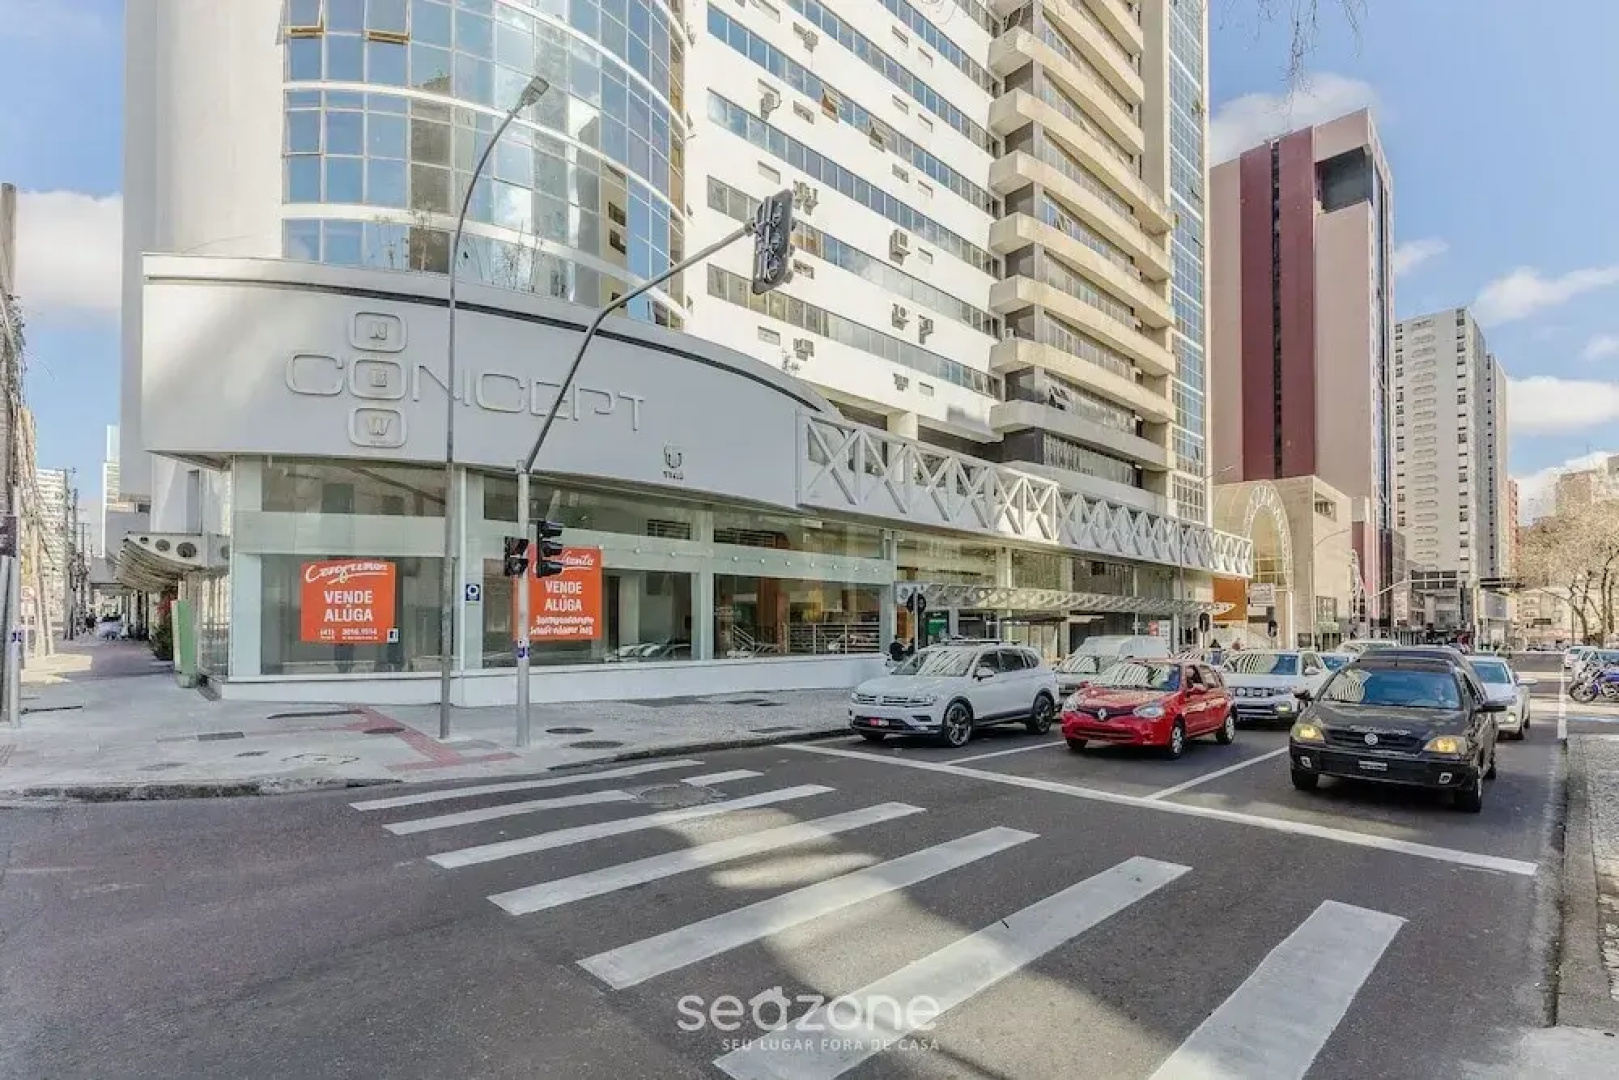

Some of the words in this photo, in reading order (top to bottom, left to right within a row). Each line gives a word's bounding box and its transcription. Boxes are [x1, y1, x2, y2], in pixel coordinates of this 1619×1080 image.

[544, 580, 583, 595] VENDE
[323, 590, 373, 605] VENDE
[543, 598, 582, 612] ALUGA
[323, 607, 373, 623] ALUGA
